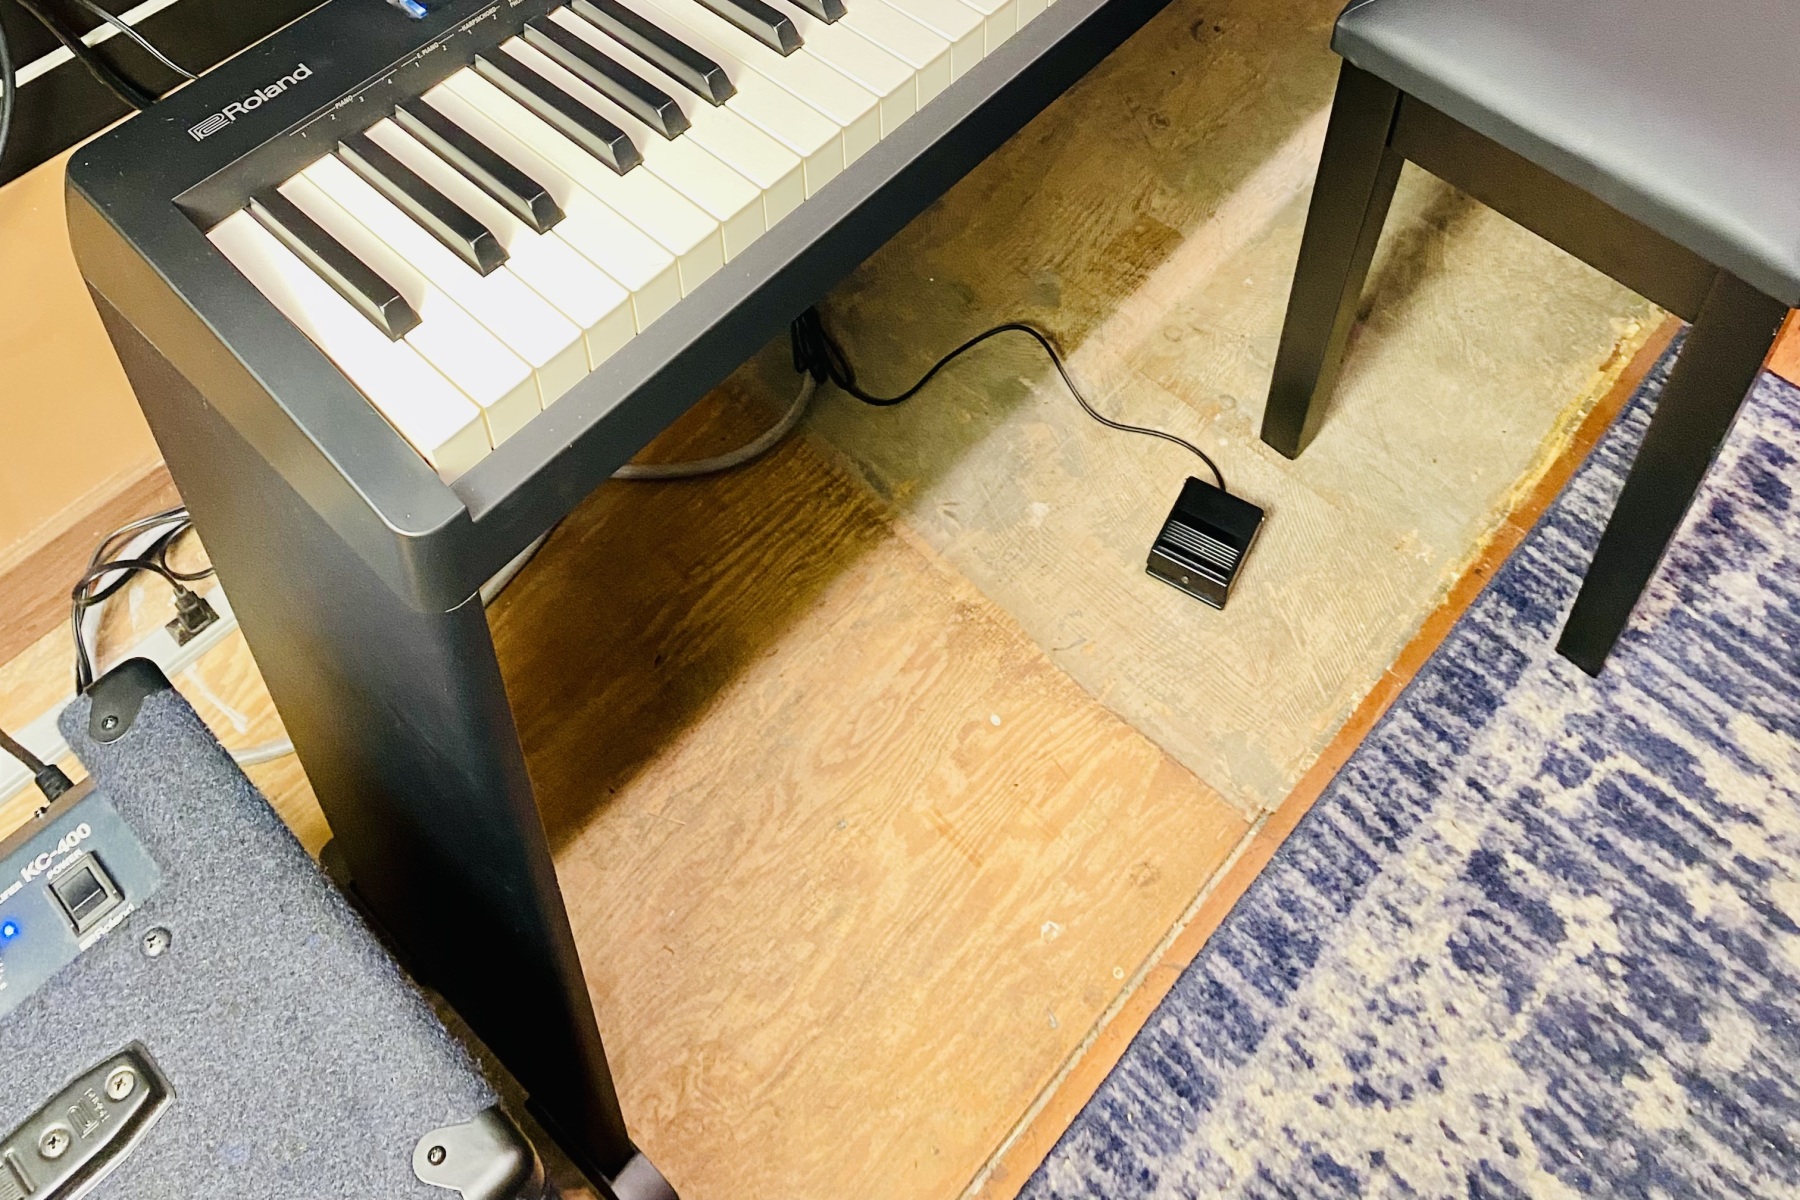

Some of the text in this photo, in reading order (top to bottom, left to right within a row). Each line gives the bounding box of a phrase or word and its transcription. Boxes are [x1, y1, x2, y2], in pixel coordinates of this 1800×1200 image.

[461, 6, 497, 31] HARPSICHORD
[221, 63, 313, 121] Roland
[335, 94, 353, 110] PIANO
[20, 822, 92, 883] KC-400
[46, 848, 84, 880] POWER
